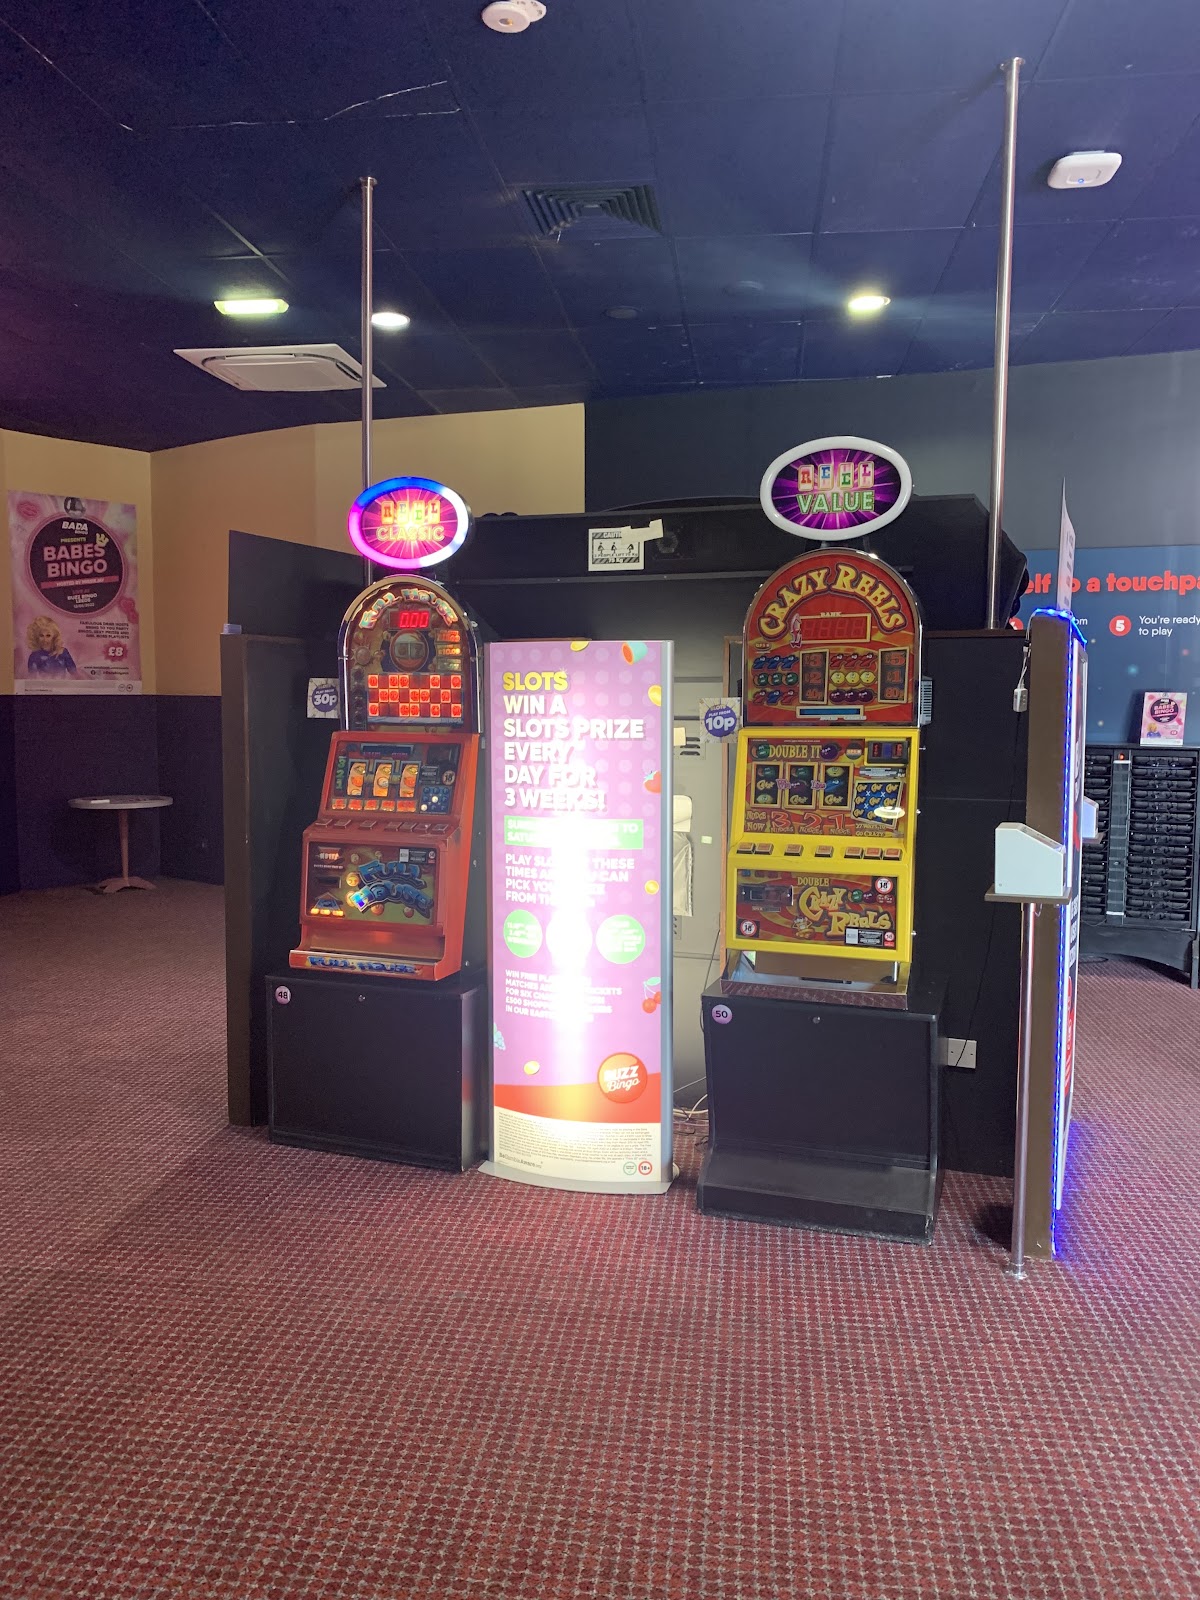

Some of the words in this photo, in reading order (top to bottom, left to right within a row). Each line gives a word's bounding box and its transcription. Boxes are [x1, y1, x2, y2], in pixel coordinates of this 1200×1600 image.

[800, 463, 872, 487] REEL
[796, 491, 875, 514] VALUE
[382, 501, 439, 522] REEL
[61, 521, 88, 531] BADA
[376, 526, 445, 542] CLASSIC
[43, 543, 105, 561] BABES
[47, 559, 107, 578] BINGO
[1025, 573, 1051, 594] elf
[1087, 577, 1100, 592] a
[760, 569, 829, 635] CRAZY
[1116, 620, 1125, 632] 5
[1139, 615, 1170, 625] You're
[1173, 615, 1200, 626] ready
[1139, 627, 1149, 636] to
[1152, 627, 1173, 638] play
[108, 647, 123, 656] £8
[502, 672, 568, 691] SLOTS
[314, 694, 337, 706] 30p
[503, 695, 545, 715] WIN
[549, 695, 567, 715] A
[503, 718, 570, 739] SLOTS
[575, 719, 644, 739] PRIZE
[706, 716, 735, 731] 10p
[504, 742, 575, 762] EVERY
[769, 744, 808, 759] DOUBLE
[811, 744, 822, 759] IT
[504, 765, 544, 785] DAY
[549, 766, 597, 787] FOR
[504, 788, 516, 807] 3
[518, 788, 606, 810] WEEKS!
[746, 822, 766, 831] NOW
[771, 811, 791, 829] 3
[803, 812, 822, 829] 2
[829, 813, 844, 830] 1
[623, 824, 638, 833] TO
[505, 853, 532, 866] PLAY
[592, 858, 635, 870] THESE
[358, 859, 427, 889] FULL
[505, 866, 537, 879] TIMES
[602, 871, 629, 882] CAN
[798, 876, 830, 887] DOUBLE
[505, 878, 530, 890] PICK
[350, 881, 433, 918] HOUSE
[505, 890, 536, 904] FROM
[799, 887, 847, 921] CRAZY
[505, 969, 519, 979] WIN
[505, 978, 538, 991] MATCHES
[505, 987, 519, 996] FOR
[278, 990, 288, 999] 48
[505, 996, 523, 1005] £500
[505, 1005, 513, 1013] IN
[513, 1007, 529, 1016] OUR
[715, 1010, 728, 1018] 50
[604, 1065, 639, 1082] BUZZ
[607, 1077, 640, 1092] Bingo
